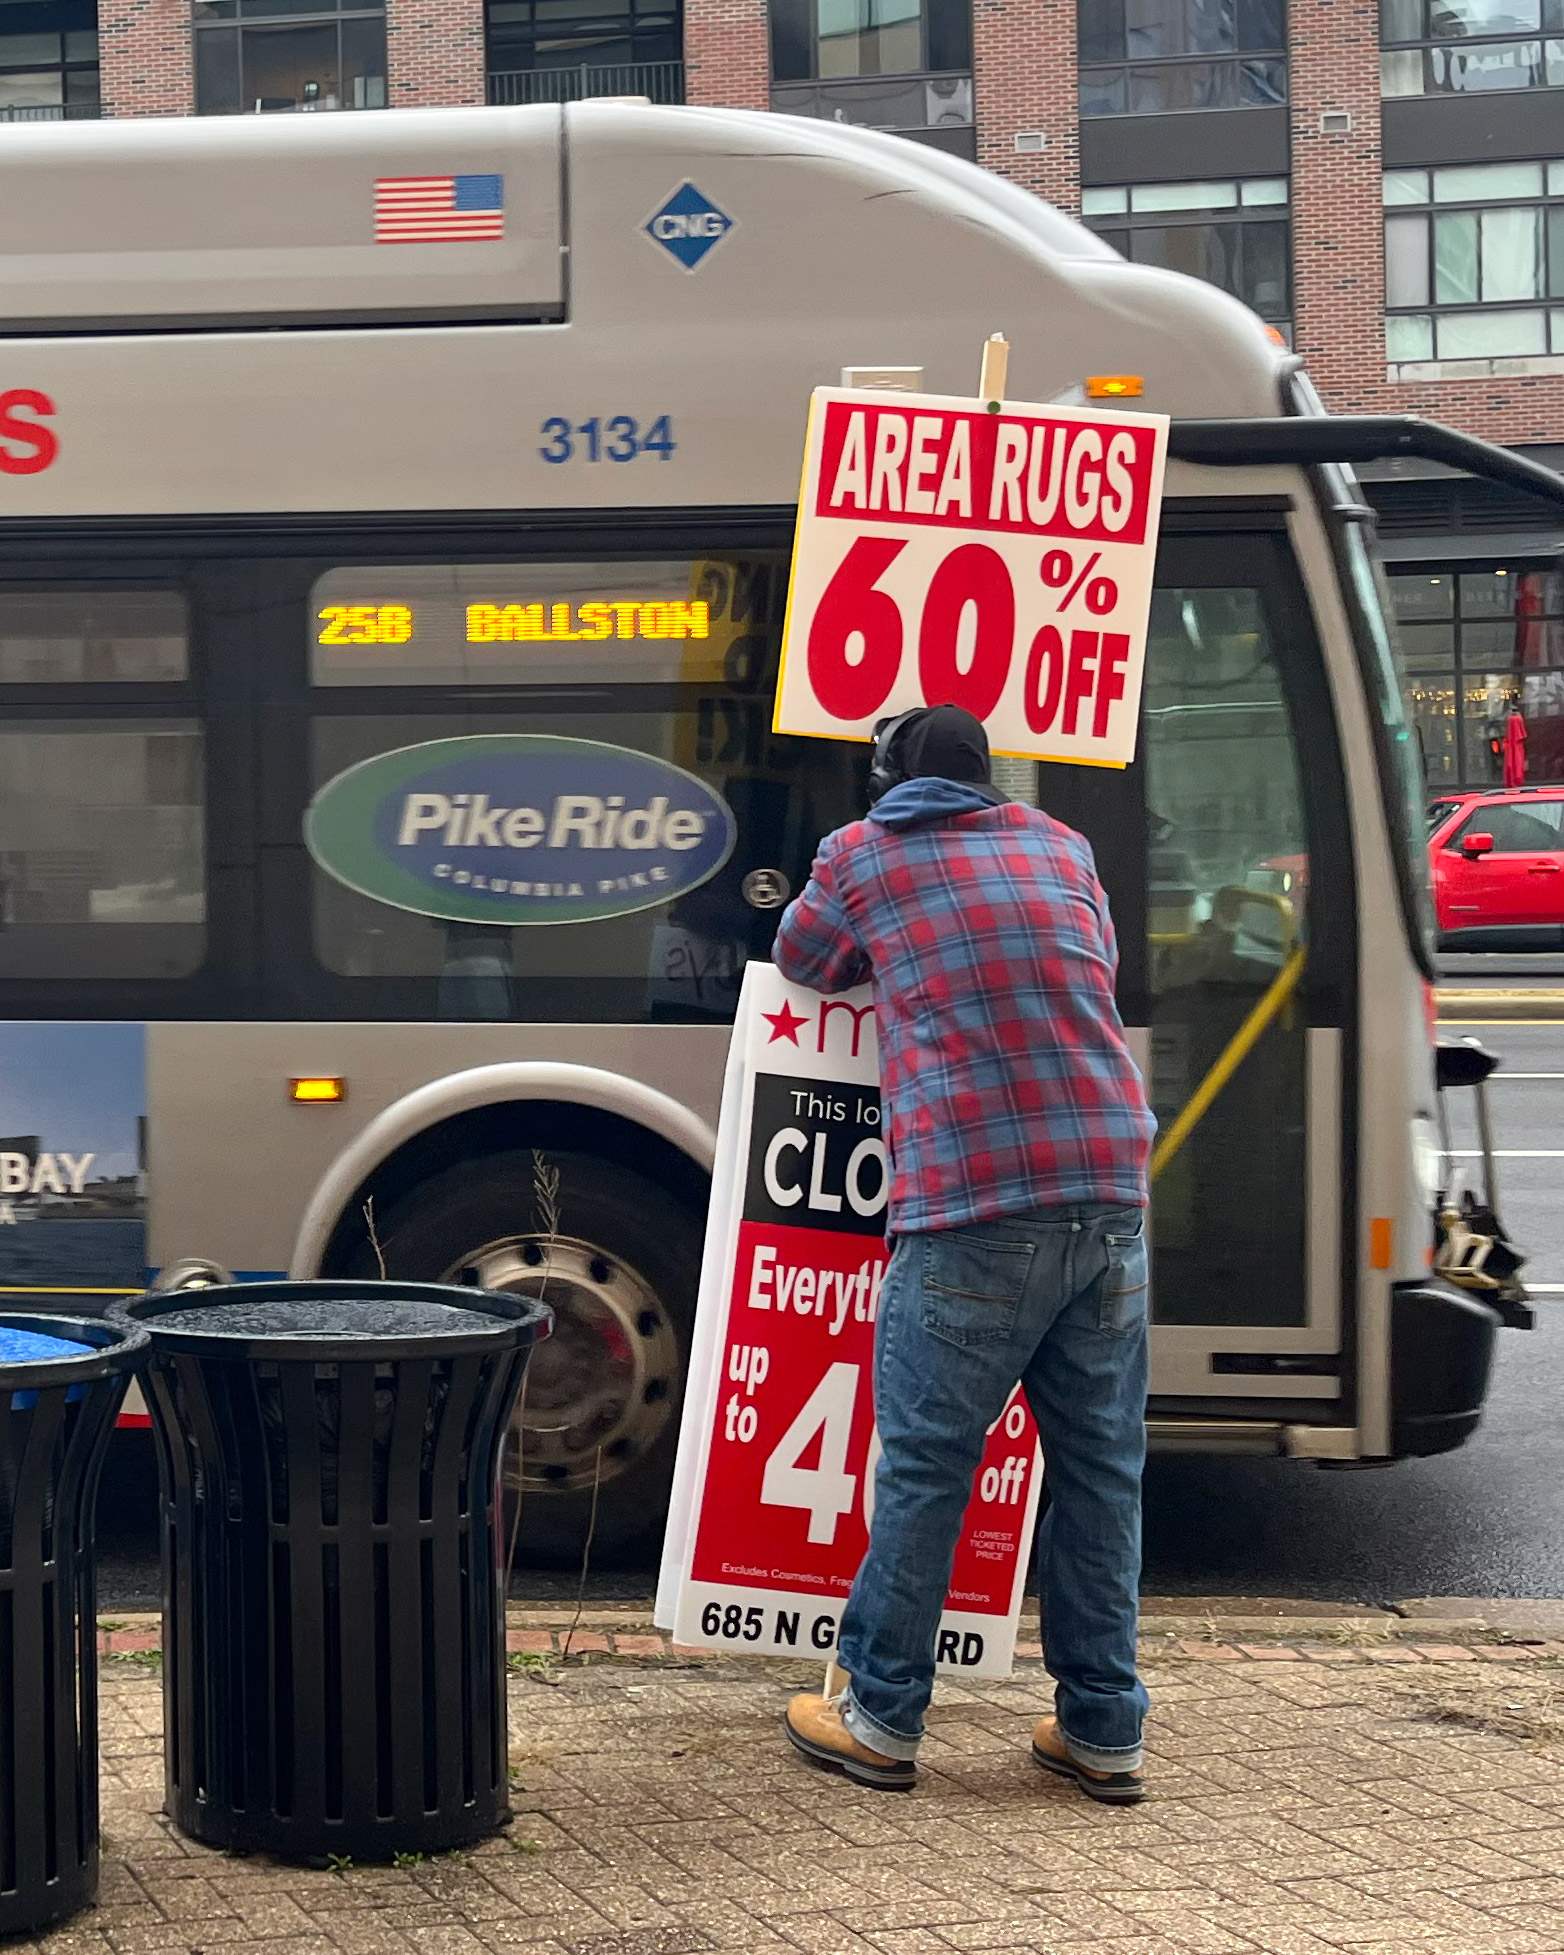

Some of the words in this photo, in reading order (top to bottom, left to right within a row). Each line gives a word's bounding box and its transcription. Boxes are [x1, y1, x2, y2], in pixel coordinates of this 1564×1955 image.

[652, 212, 727, 239] CNG
[0, 389, 60, 474] S
[538, 415, 677, 464] 3134
[829, 411, 973, 518] AREA
[988, 422, 1136, 533] RUGS
[1039, 549, 1119, 616] %
[465, 600, 710, 643] BALLSTON
[807, 536, 1016, 724] 60
[1024, 624, 1131, 738] OFF
[432, 862, 585, 897] COLUMBIA
[597, 866, 670, 894] PIKE
[790, 1090, 846, 1122] This
[0, 1152, 96, 1194] BAY
[763, 1126, 889, 1218] CLO
[729, 1344, 769, 1396] up
[725, 1393, 758, 1443] to
[760, 1361, 882, 1545] 4
[980, 1456, 1028, 1505] off
[970, 1539, 1015, 1552] TICKETED
[973, 1530, 1014, 1541] LOWEST
[976, 1551, 1004, 1561] PRICE
[721, 1562, 768, 1578] Excludes
[770, 1568, 827, 1586] Cosmetics,
[949, 1589, 990, 1603] Vendors
[701, 1602, 764, 1641] 685
[774, 1610, 800, 1646] N
[936, 1629, 984, 1666] RD
